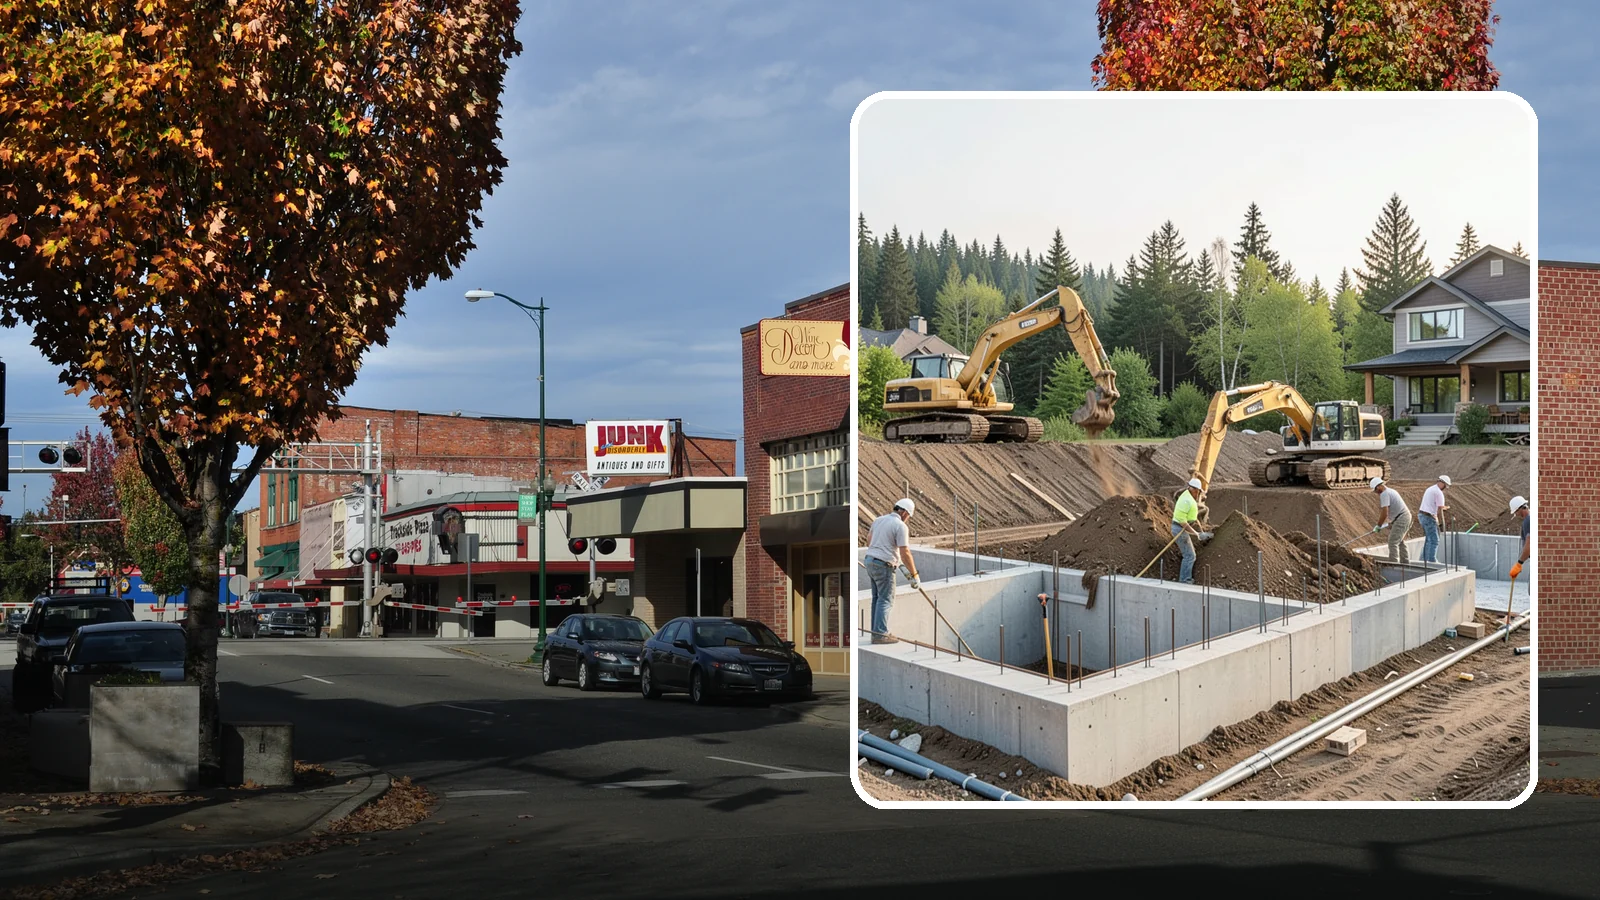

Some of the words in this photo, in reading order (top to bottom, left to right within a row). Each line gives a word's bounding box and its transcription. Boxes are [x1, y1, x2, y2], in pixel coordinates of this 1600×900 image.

[595, 425, 664, 457] JUNK
[607, 446, 646, 454] DISORDERLY
[597, 461, 628, 470] ANTIQUES
[631, 461, 644, 470] AND
[647, 460, 666, 469] GIFTS
[573, 473, 589, 491] RAIL
[390, 521, 412, 539] Trackside
[414, 520, 429, 534] Pizza
